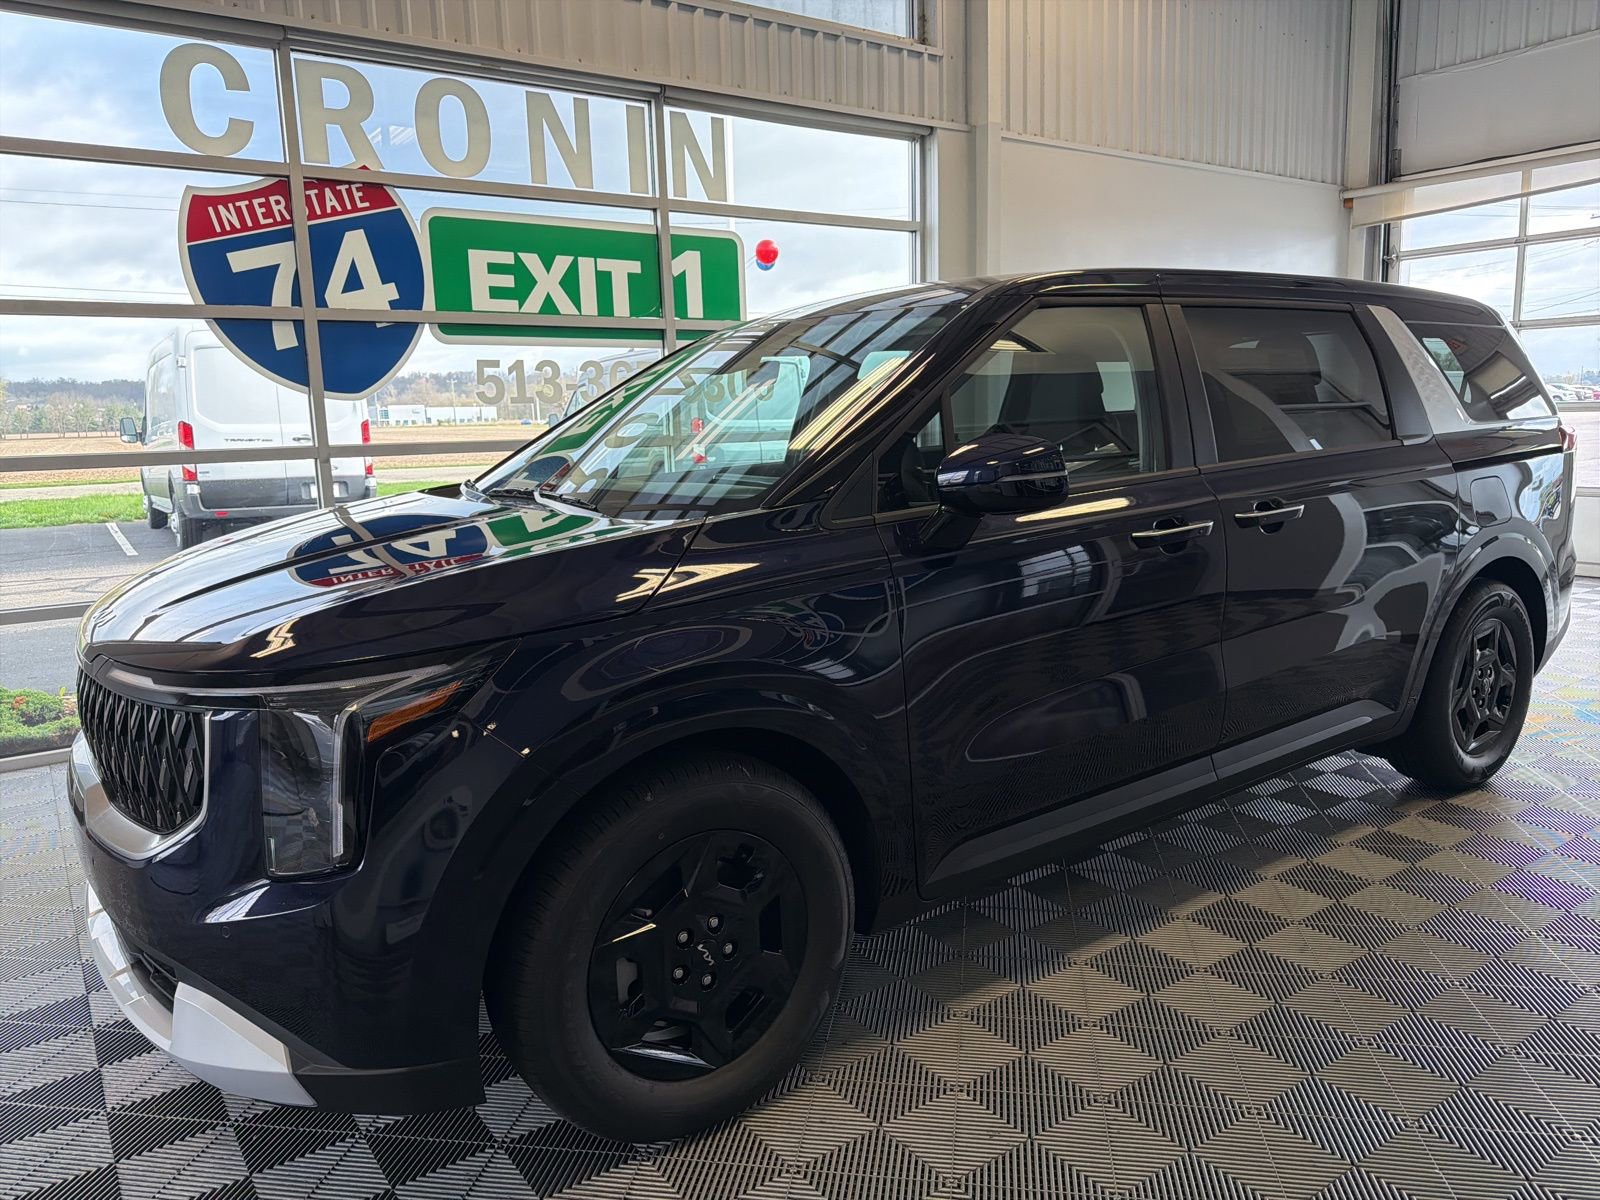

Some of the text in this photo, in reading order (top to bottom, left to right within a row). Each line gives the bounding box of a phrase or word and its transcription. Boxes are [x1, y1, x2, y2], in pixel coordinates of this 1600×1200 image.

[160, 43, 728, 202] CRONIN
[207, 183, 370, 233] INTERTATE
[226, 229, 400, 351] 74
[468, 249, 704, 319] EXIT 1
